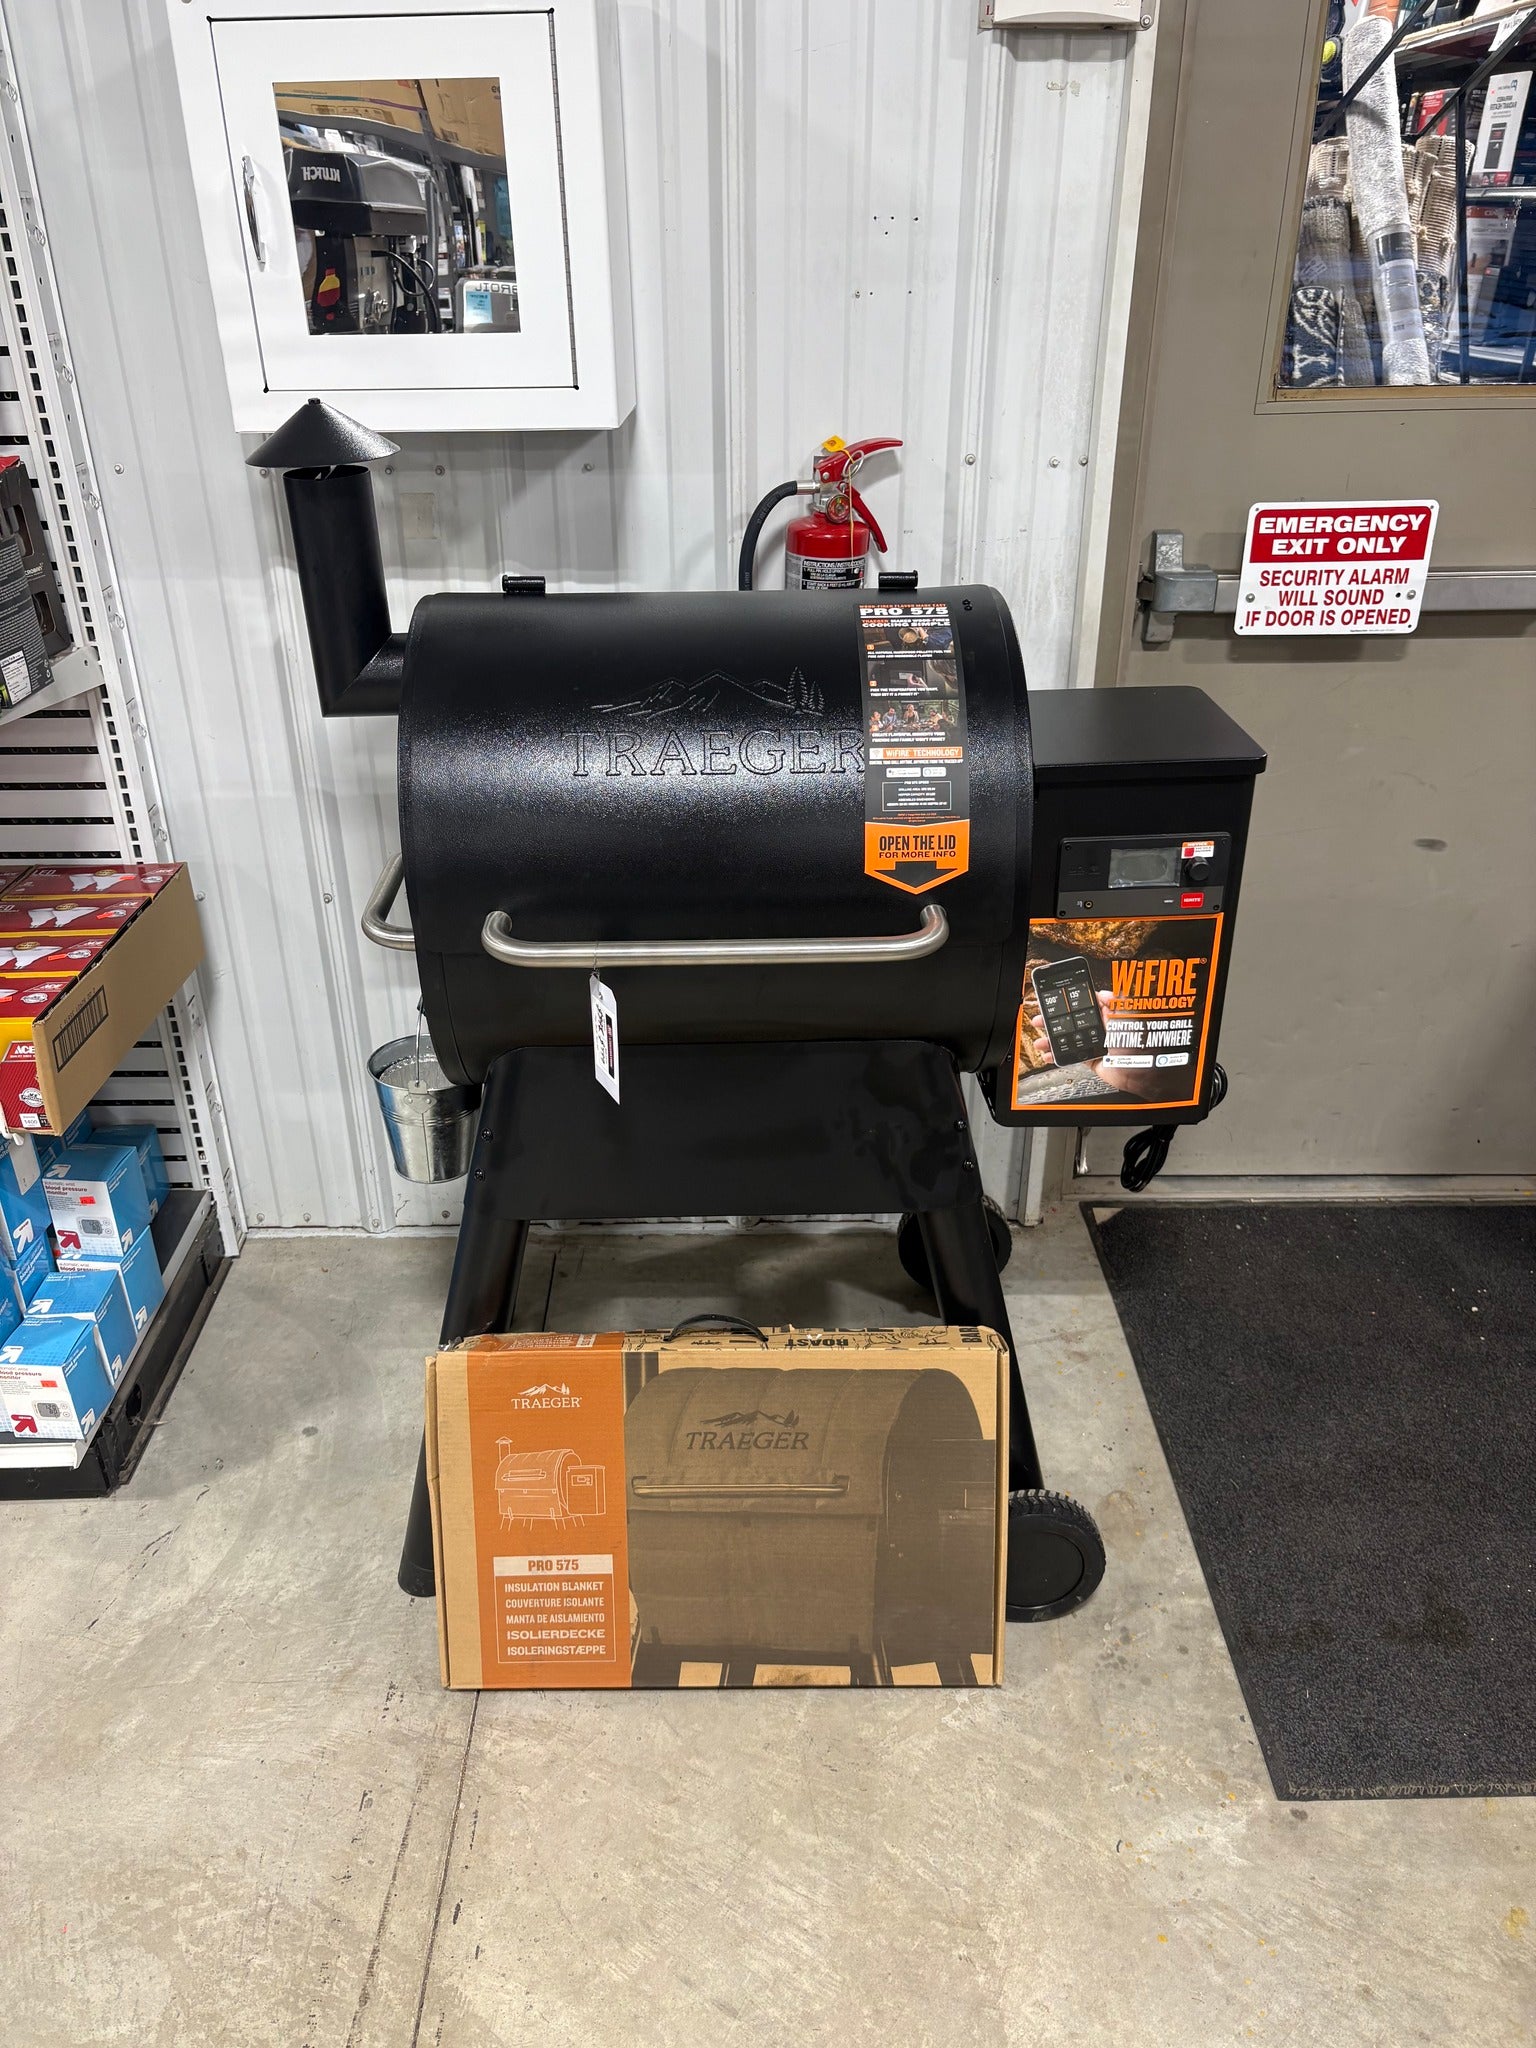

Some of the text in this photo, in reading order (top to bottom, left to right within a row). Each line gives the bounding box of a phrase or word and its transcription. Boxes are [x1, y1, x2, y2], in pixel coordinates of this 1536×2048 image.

[1259, 514, 1426, 534] EMERGENCY
[1272, 536, 1407, 556] EXIT ONLY
[1259, 568, 1410, 587] SECURITY ALARM
[1278, 589, 1384, 606] WILL SOUND
[1245, 608, 1411, 627] IF DOOR IS OPENED
[560, 729, 865, 776] TRAEGER
[886, 748, 959, 757] WiFIRE TECHNOLOGY
[880, 835, 956, 851] OPEN THE LID
[1111, 958, 1200, 997] WiFIRE
[1110, 996, 1196, 1010] TECHNOLOGY
[1106, 1019, 1193, 1031] CONTROL YOUR GRILL
[1104, 1030, 1192, 1049] ANYTIME, ANYWHERE
[15, 1045, 36, 1054] ACE
[784, 1337, 849, 1347] ROAST
[511, 1396, 580, 1410] TRAEGER
[686, 1431, 810, 1451] TRAEGER
[528, 1559, 579, 1571] PRO 575
[505, 1581, 604, 1592] INSULATION BLANKET
[506, 1597, 604, 1608] COUVERTURE ISOLANTE
[506, 1613, 605, 1624] MANTA DE AISLAMIENTO
[507, 1629, 605, 1640] ISOLIERDECKE
[507, 1645, 606, 1656] ISOLERINGSTÆPPE
